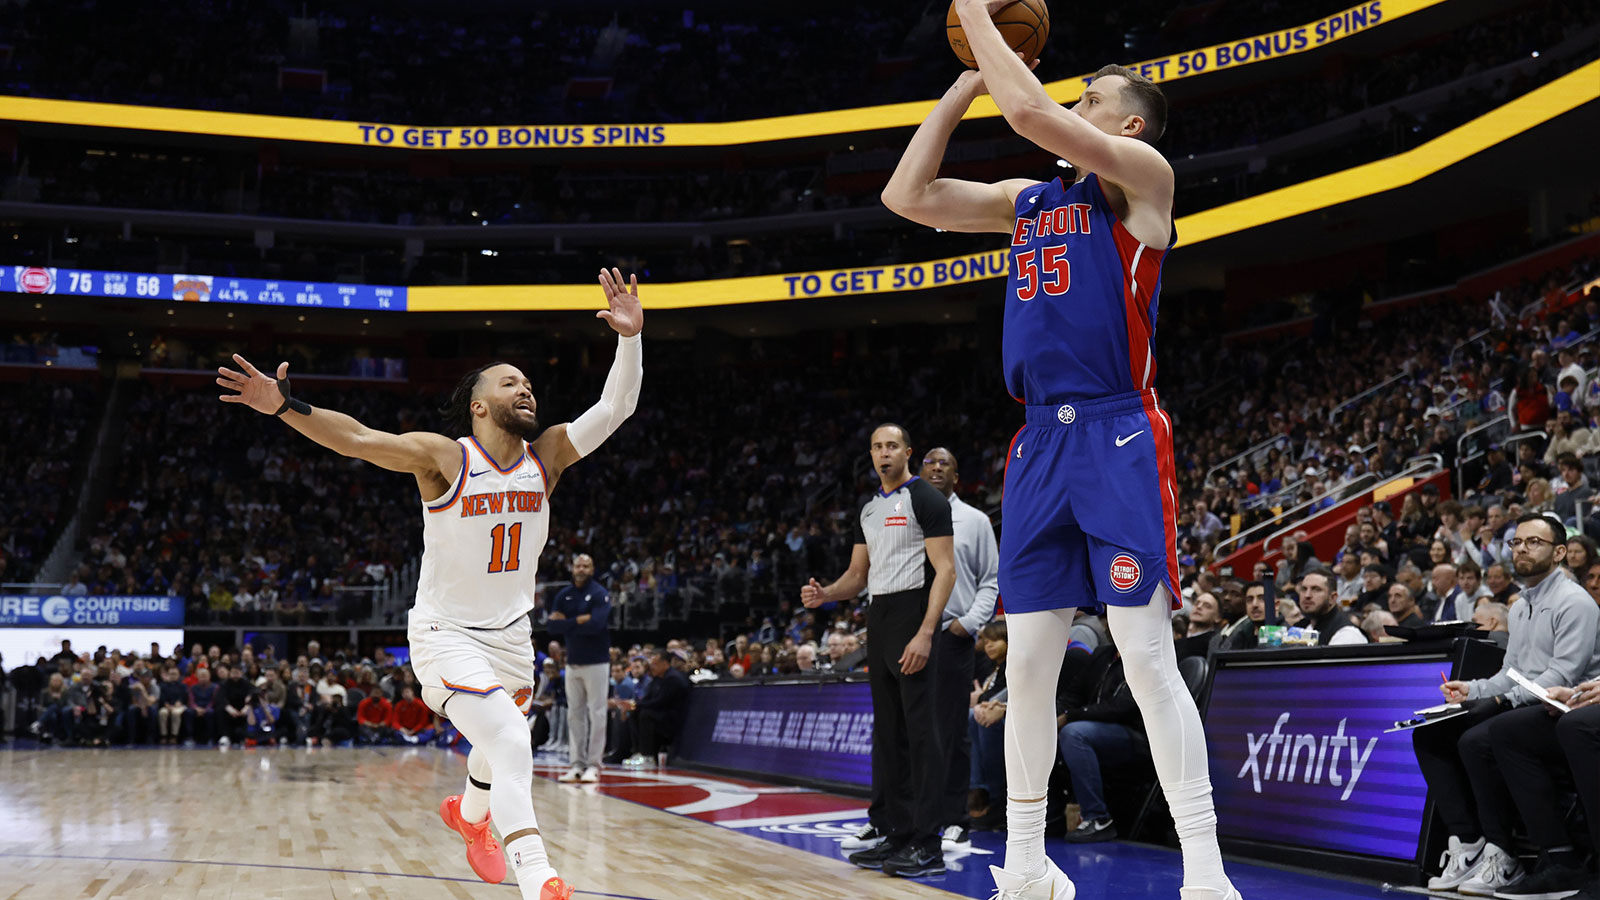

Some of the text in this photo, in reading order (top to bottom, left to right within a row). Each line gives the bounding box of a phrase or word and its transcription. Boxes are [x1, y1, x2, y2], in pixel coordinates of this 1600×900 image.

[1129, 59, 1170, 80] ET
[1177, 54, 1207, 77] 50
[1215, 29, 1308, 68] BONUS
[1315, 1, 1383, 44] SPINS
[358, 125, 665, 147] TO GET 50 BONUS SPINS
[69, 272, 92, 293] 75
[784, 252, 1010, 297] TO GET 50 BONU
[1015, 243, 1071, 301] 55
[461, 490, 544, 518] NEW YORK
[487, 522, 522, 573] 11
[0, 597, 40, 616] RE
[73, 597, 170, 612] COURTSIDE
[73, 611, 120, 625] CLUB
[1237, 712, 1379, 801] xfinity
